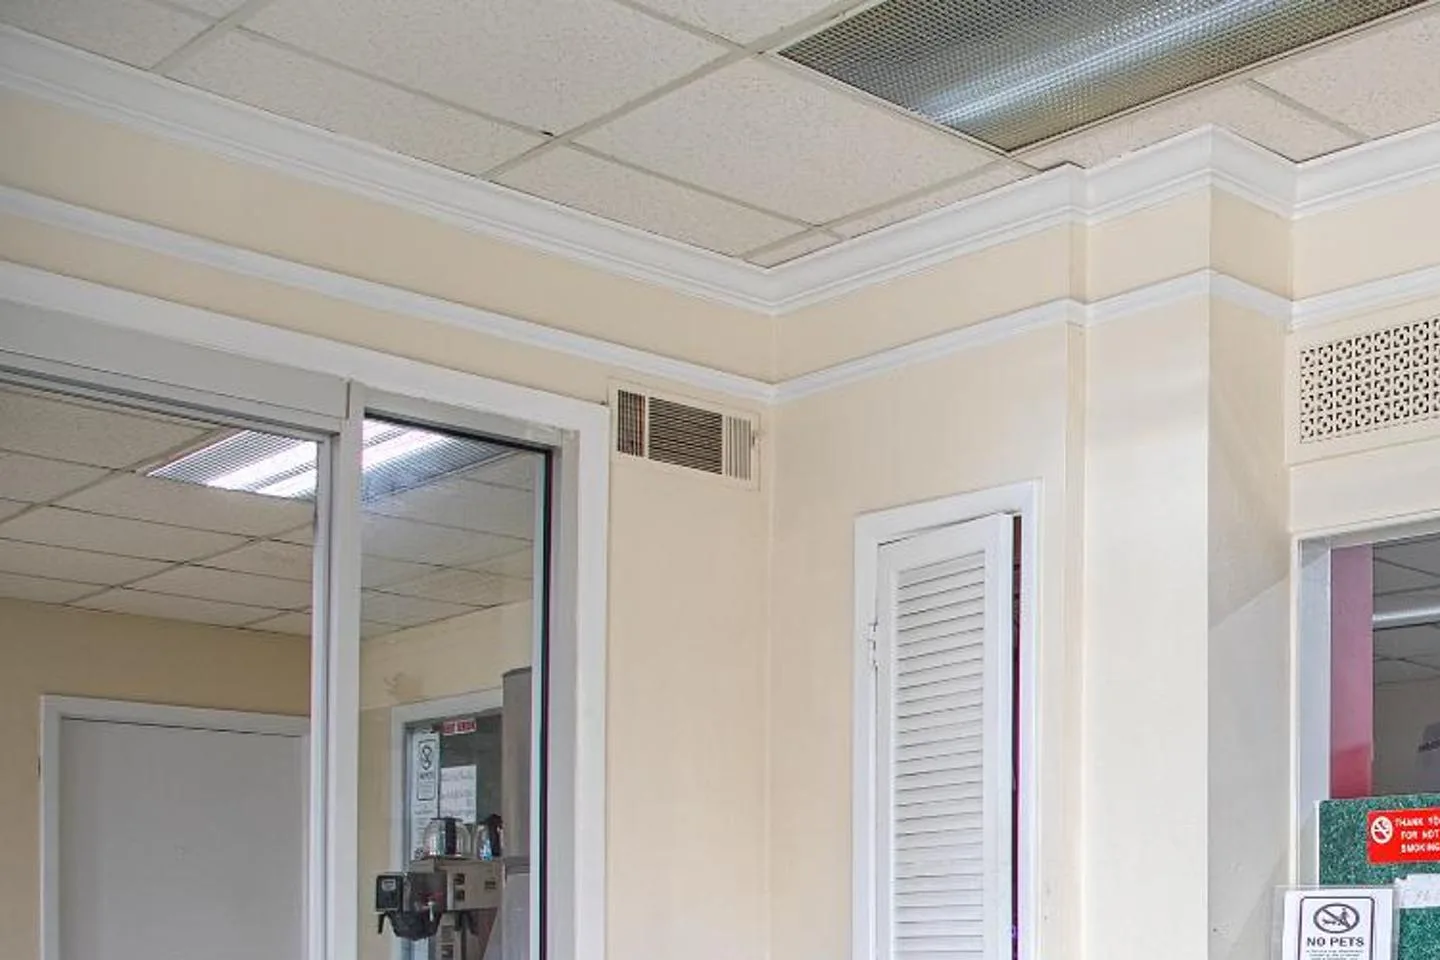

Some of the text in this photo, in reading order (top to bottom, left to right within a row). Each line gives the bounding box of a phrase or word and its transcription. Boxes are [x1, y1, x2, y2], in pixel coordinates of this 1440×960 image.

[1394, 816, 1424, 827] THANK
[1400, 828, 1440, 840] FOR NOT
[1400, 842, 1440, 853] SMOKING
[1306, 936, 1365, 948] NO PETS
